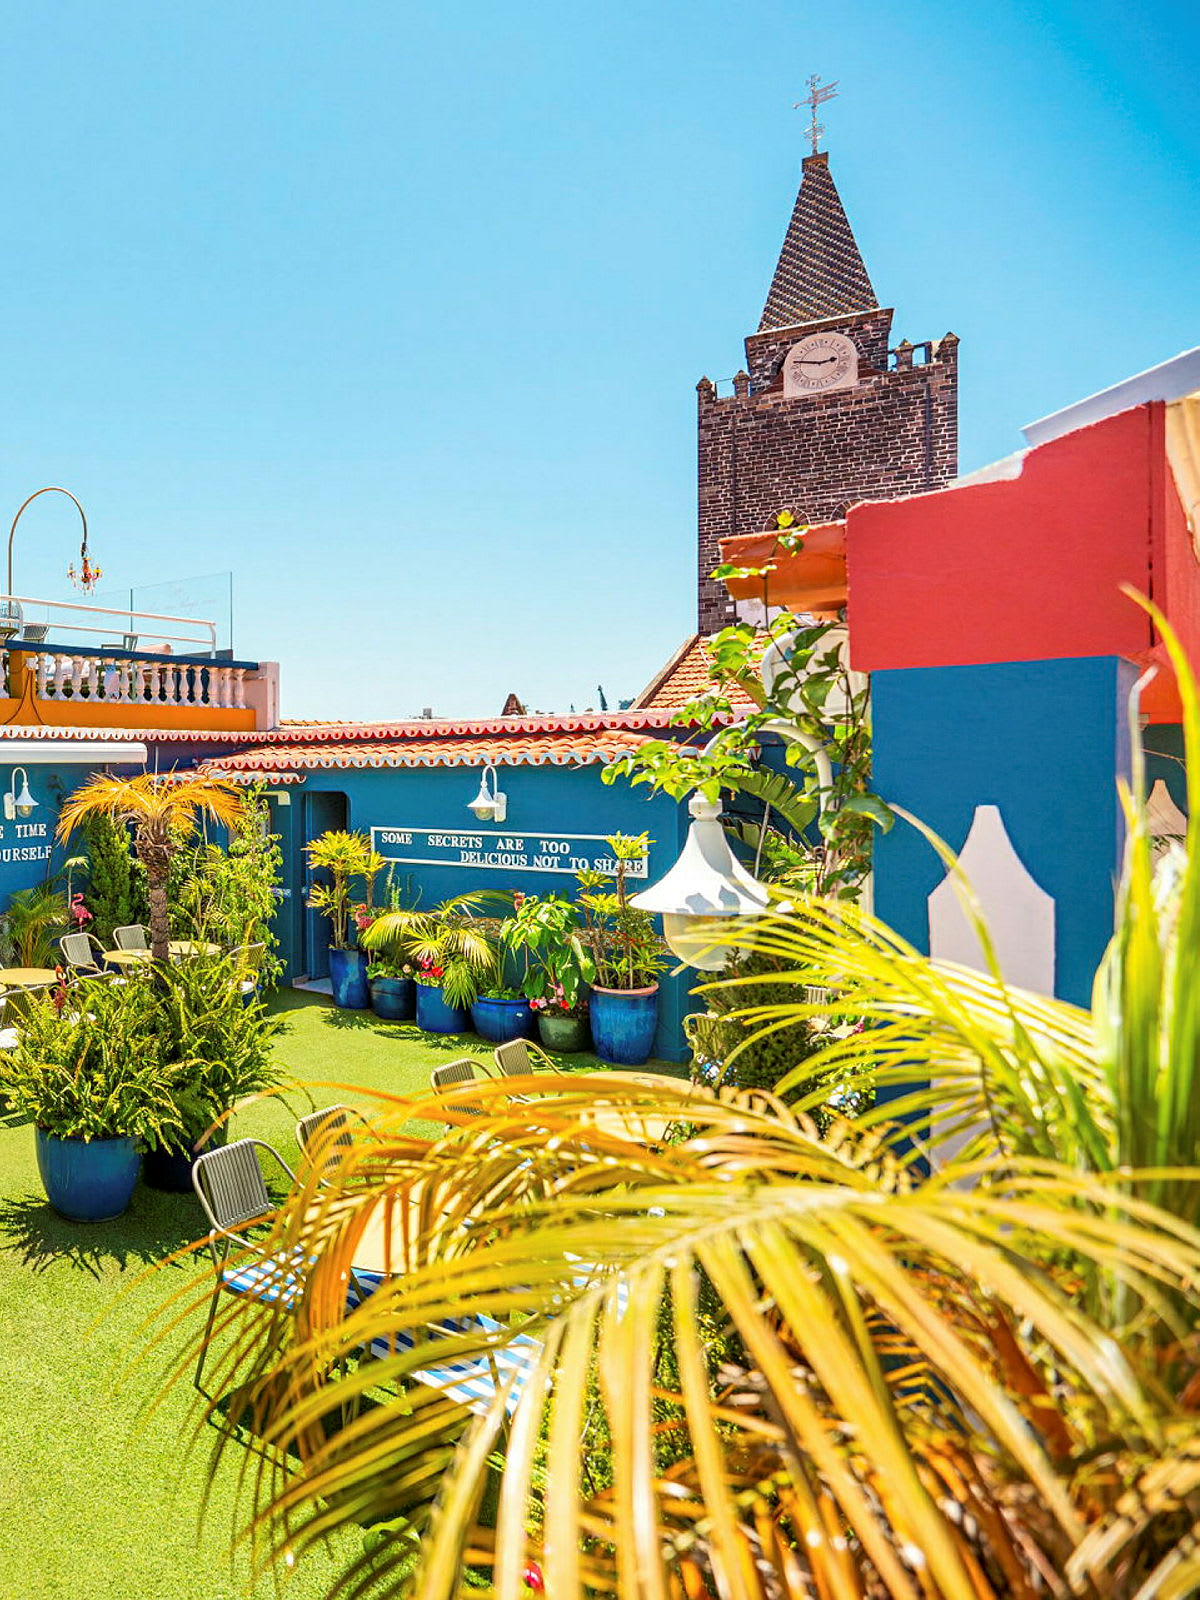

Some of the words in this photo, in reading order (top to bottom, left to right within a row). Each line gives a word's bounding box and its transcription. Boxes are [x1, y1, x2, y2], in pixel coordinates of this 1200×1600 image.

[15, 823, 47, 838] TIME
[381, 832, 412, 845] SOME
[427, 834, 483, 848] SECRETS
[496, 838, 524, 851] ARE
[540, 840, 570, 854] TOO
[460, 850, 528, 866] DELICIOUS
[533, 854, 560, 868] NOT
[569, 857, 589, 870] TO
[593, 858, 643, 872] SHARE
